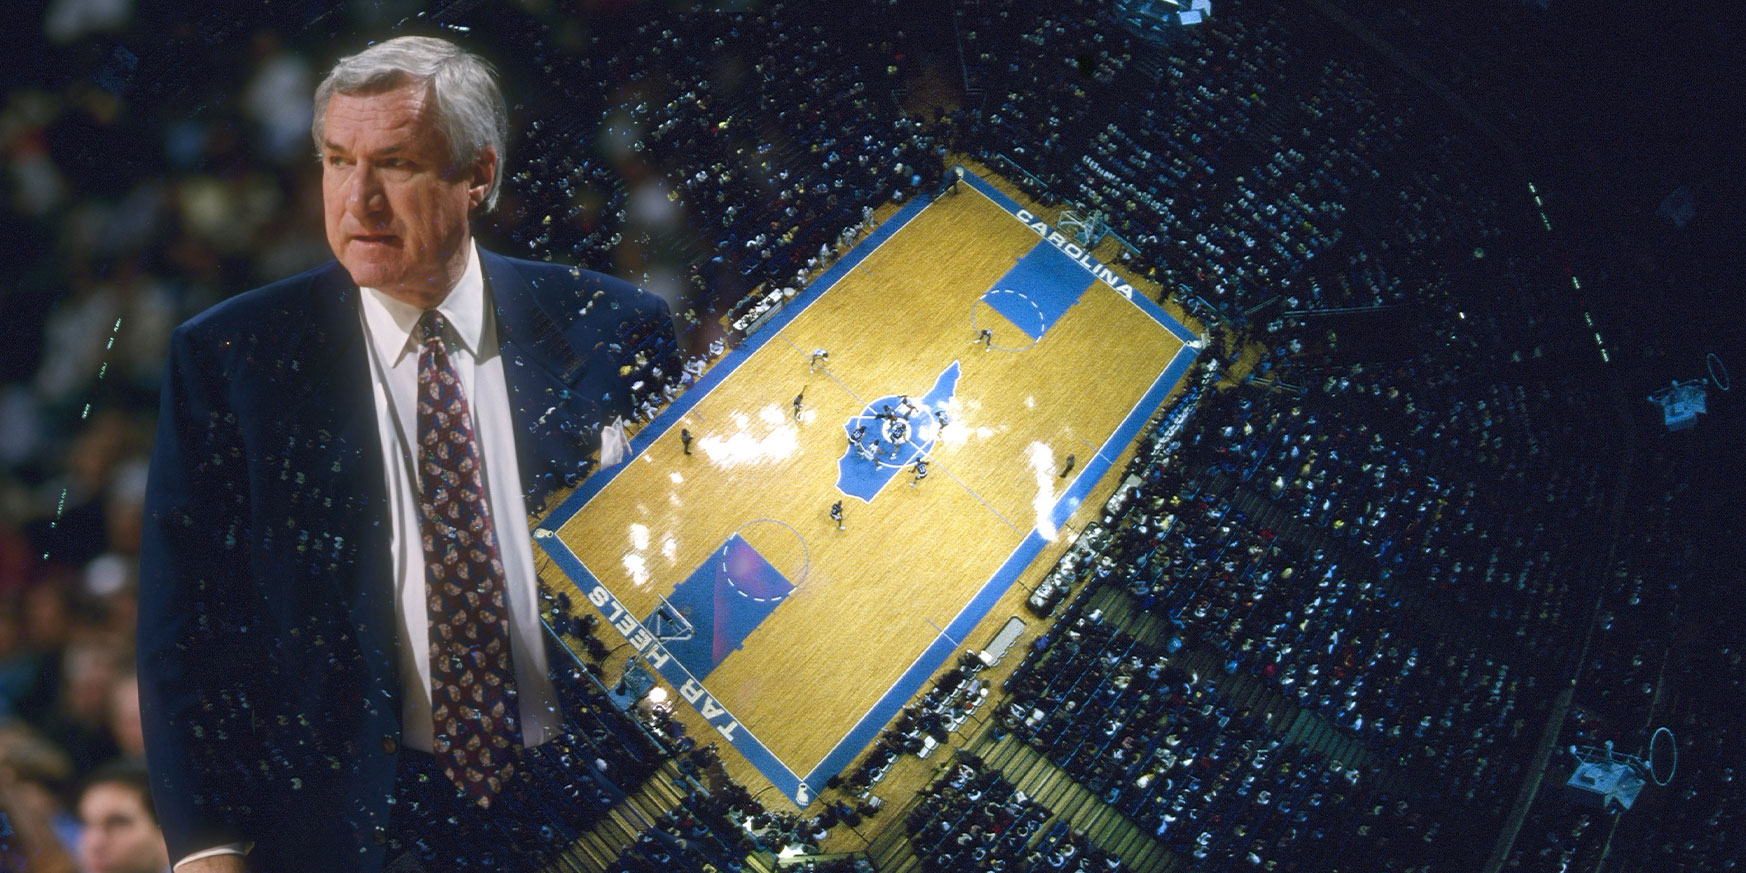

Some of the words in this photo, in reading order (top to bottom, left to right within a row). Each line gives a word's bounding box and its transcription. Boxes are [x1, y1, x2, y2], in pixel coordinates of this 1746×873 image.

[1016, 209, 1133, 300] CAROLINA
[588, 585, 670, 670] HEELS
[679, 678, 738, 742] TAR
